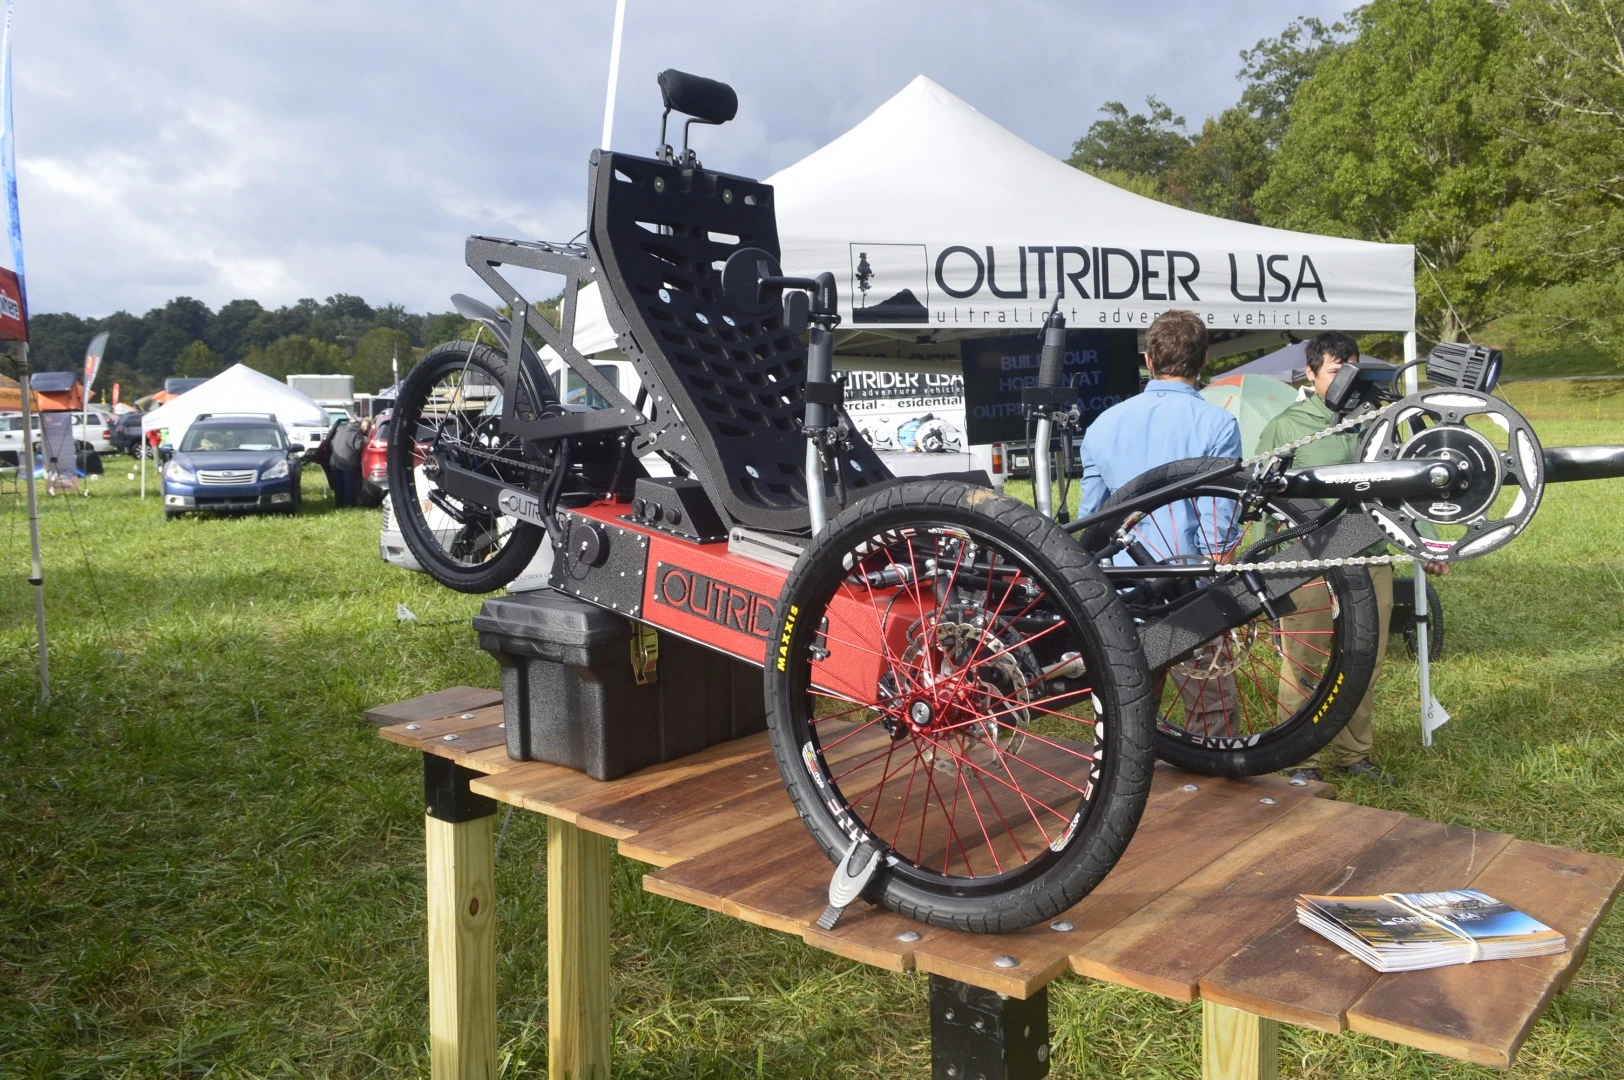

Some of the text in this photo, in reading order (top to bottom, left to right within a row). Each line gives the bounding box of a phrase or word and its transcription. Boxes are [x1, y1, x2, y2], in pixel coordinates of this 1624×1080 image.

[935, 245, 1328, 303] OUTRIDER USA
[937, 306, 1328, 326] ultralit advene vehicles
[1001, 350, 1099, 371] BUIL OUR
[831, 370, 964, 390] UTRIDER USA
[1079, 370, 1101, 387] AT
[862, 387, 917, 398] adventure
[844, 400, 878, 411] ercial
[897, 395, 963, 408] esidential
[662, 569, 775, 637] OUTRID
[777, 604, 799, 672] MAXXIS
[1312, 671, 1345, 724] MAXXIS
